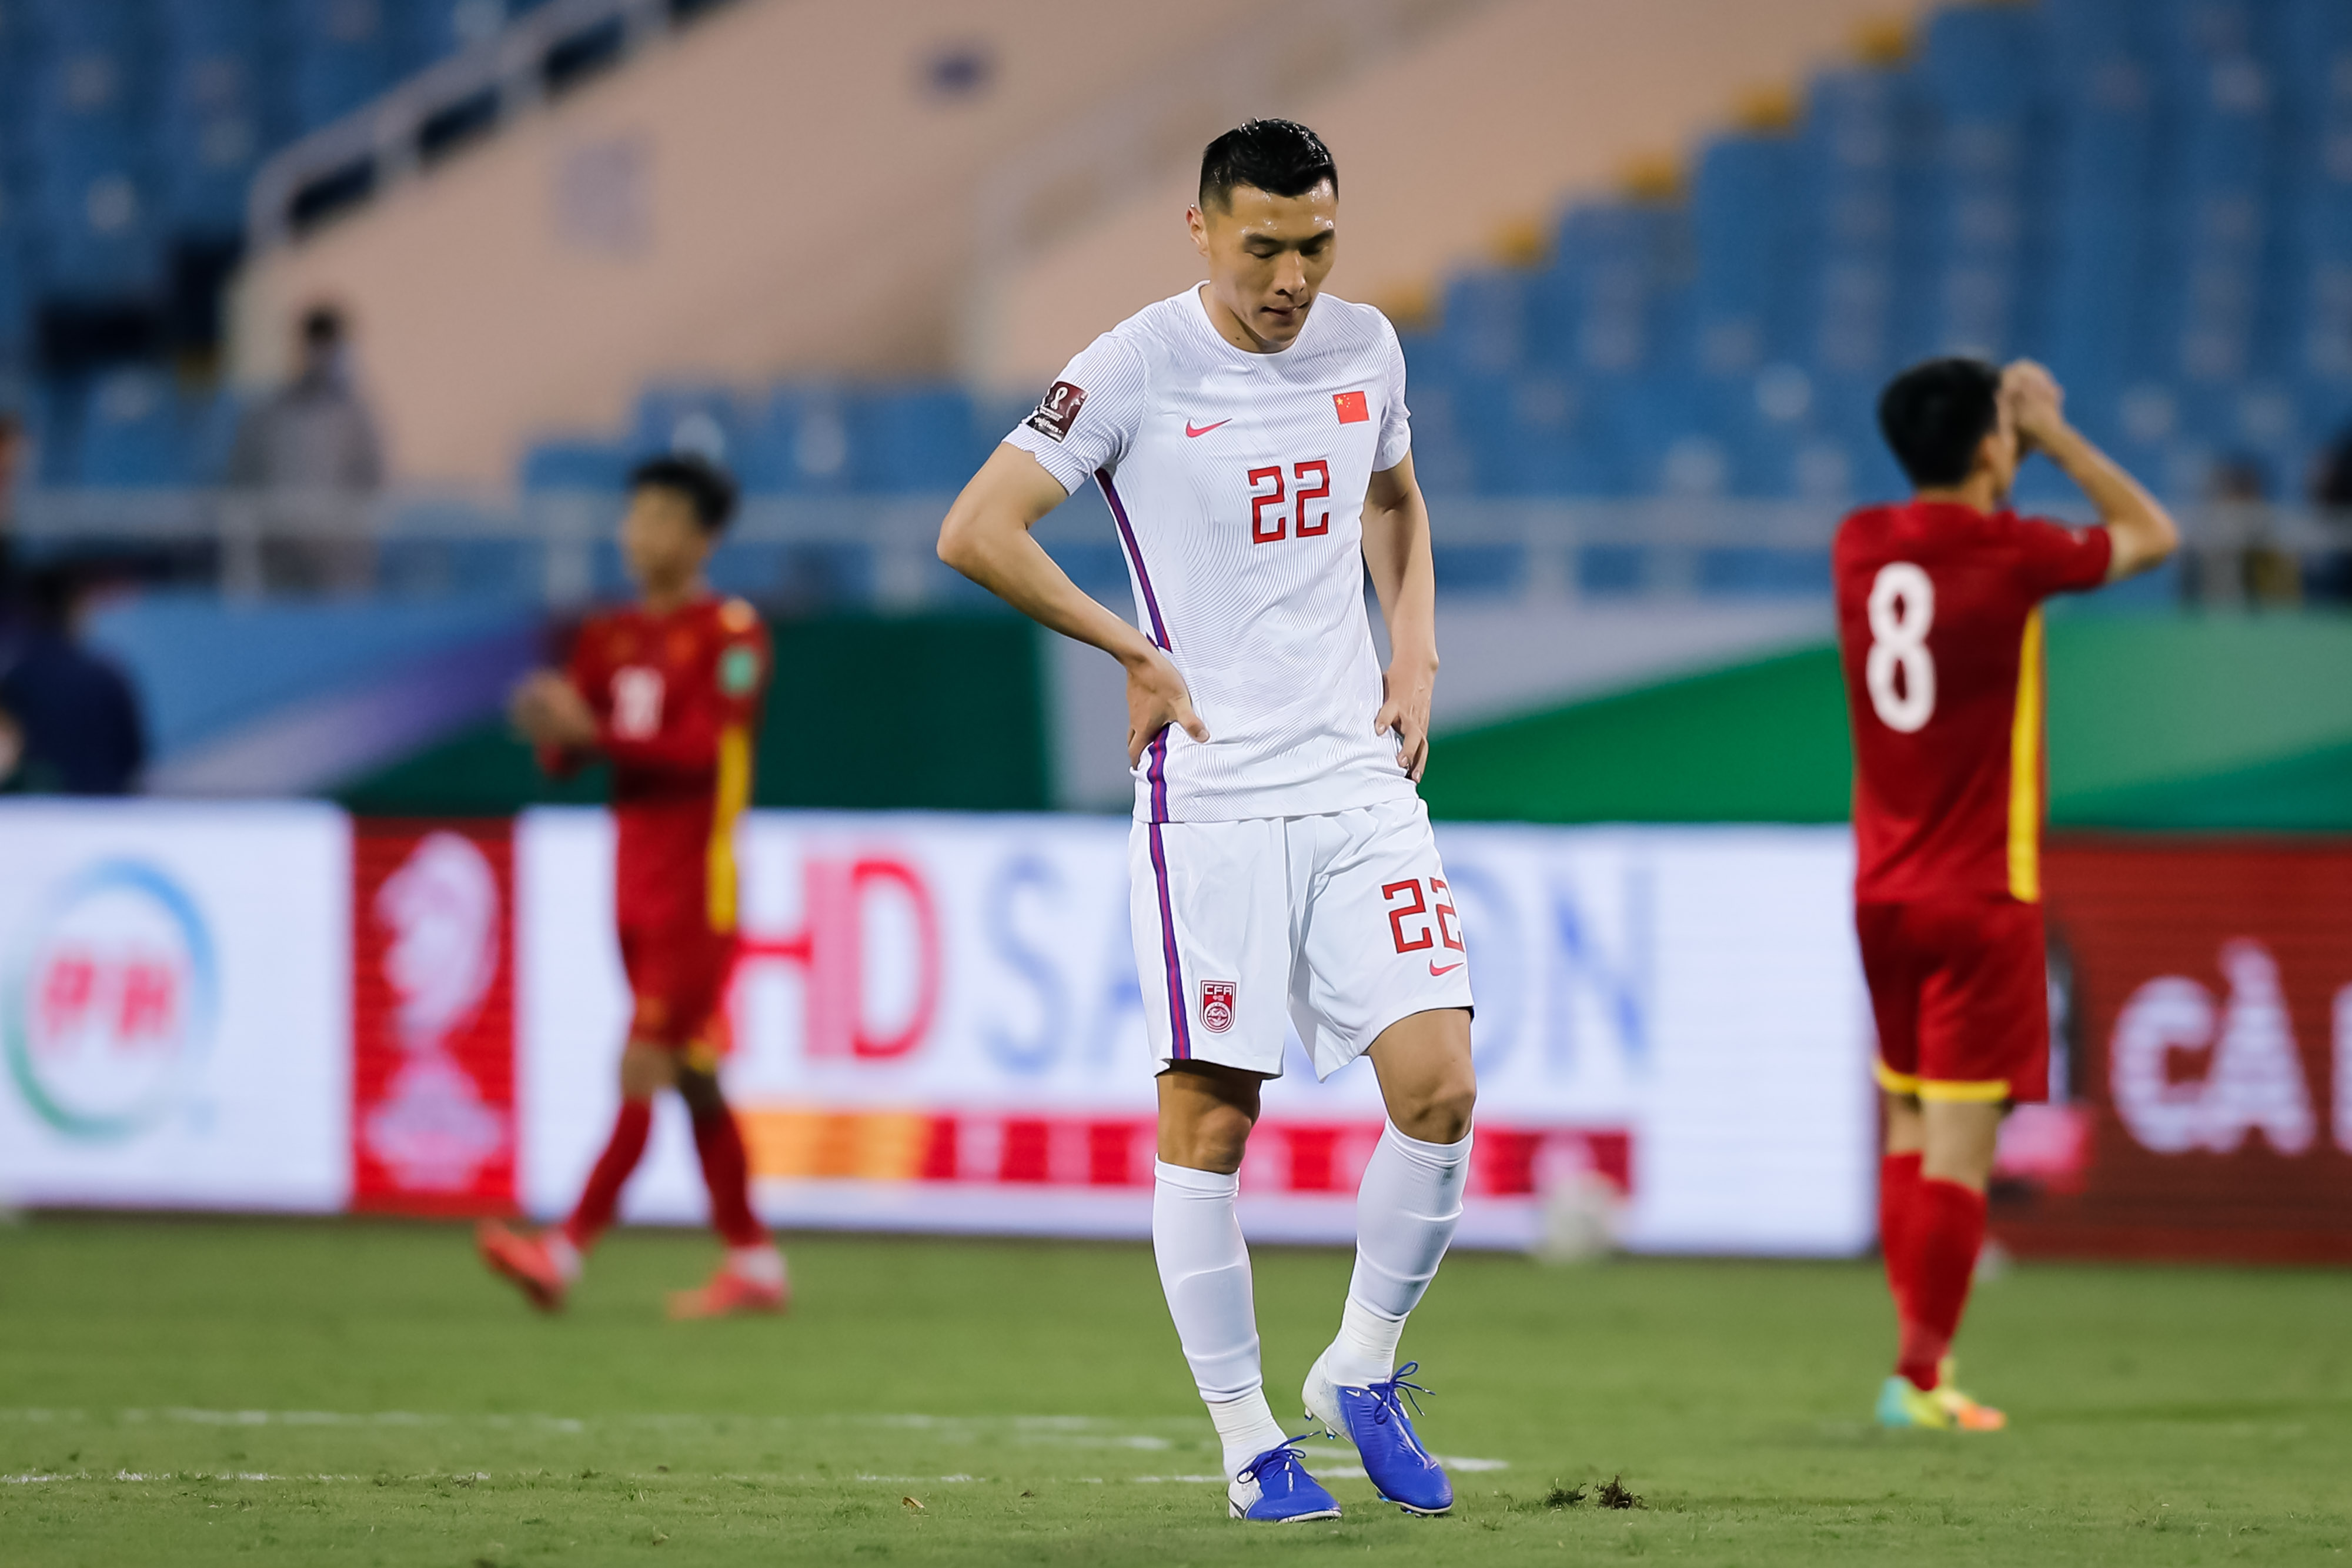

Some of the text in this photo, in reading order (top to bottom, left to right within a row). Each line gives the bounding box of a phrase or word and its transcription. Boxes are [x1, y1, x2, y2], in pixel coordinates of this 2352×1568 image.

[1248, 460, 1329, 544] 22
[1866, 561, 1936, 733] 8
[1382, 877, 1465, 954] 22
[719, 854, 946, 1067] HD
[1204, 985, 1232, 995] CFA
